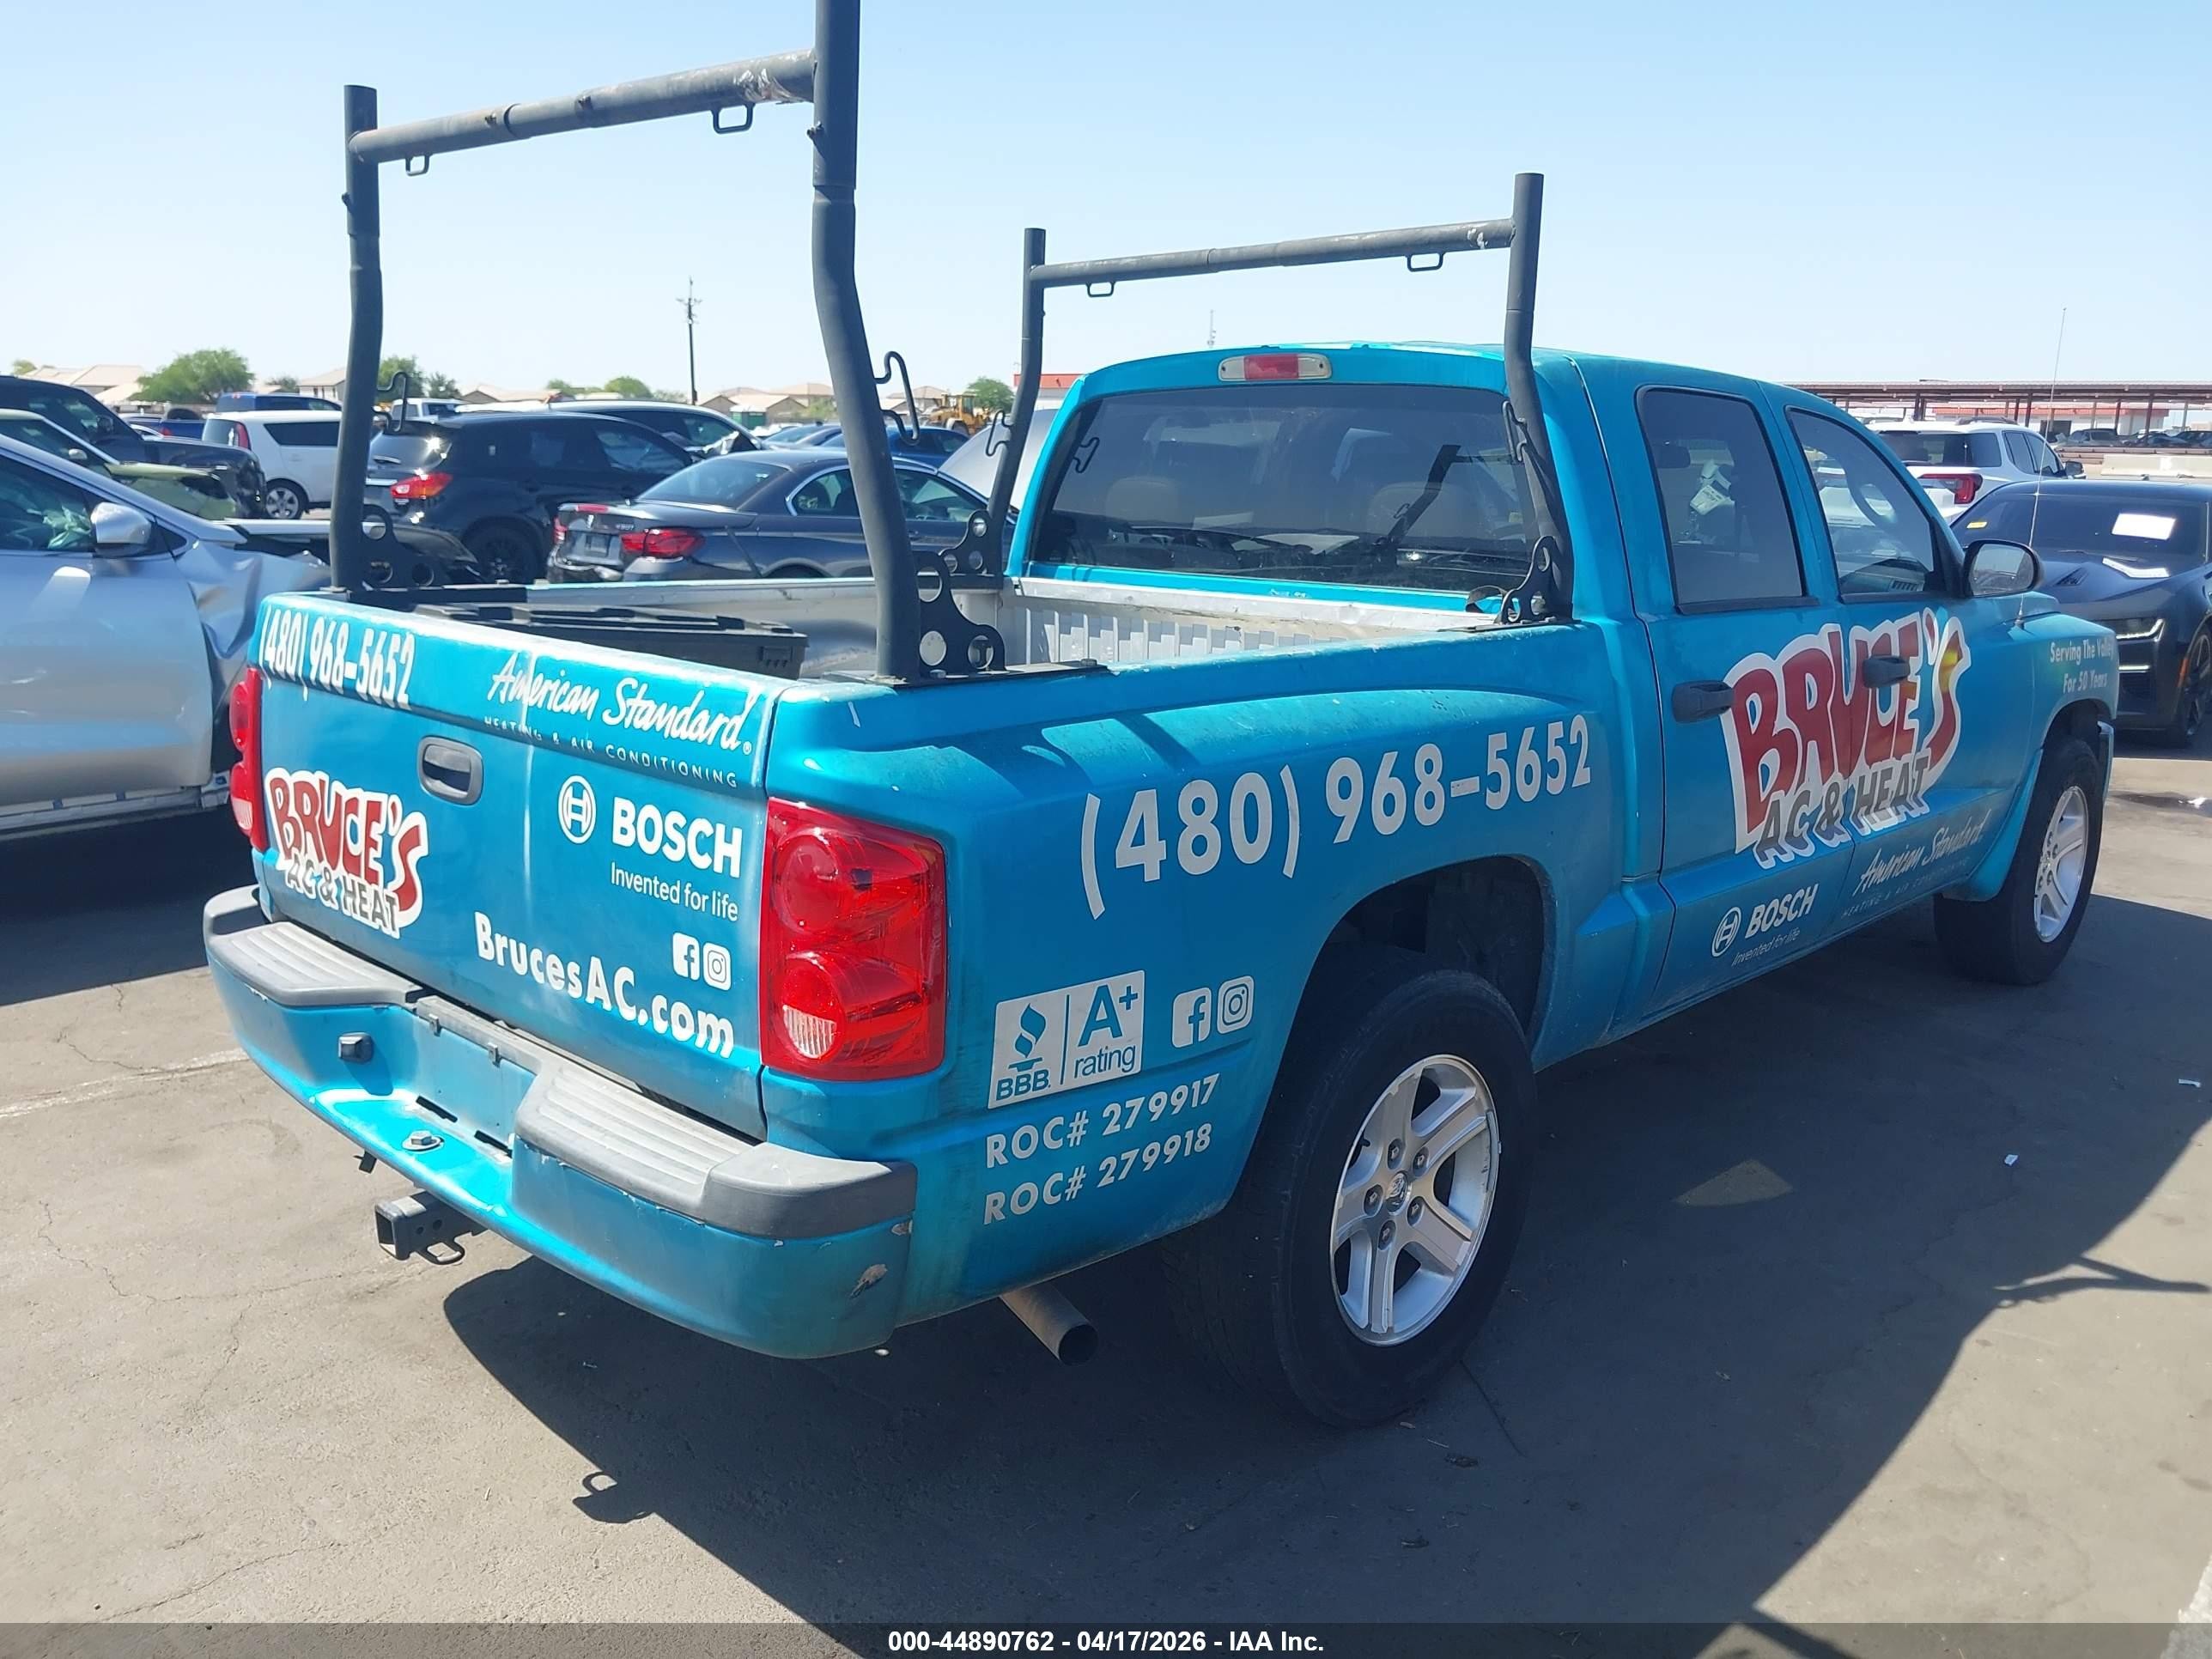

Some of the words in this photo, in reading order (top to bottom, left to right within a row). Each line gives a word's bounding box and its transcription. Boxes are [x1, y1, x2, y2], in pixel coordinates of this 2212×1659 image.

[259, 605, 309, 701] (480)
[310, 617, 415, 711] 968-5652
[487, 650, 599, 721] American
[2050, 641, 2081, 665] Serving
[2082, 639, 2095, 659] The
[2063, 672, 2076, 694] For
[2077, 670, 2088, 691] 50
[2089, 670, 2108, 689] Years
[571, 738, 594, 754] AIR
[605, 744, 738, 788] CONDITIONING
[1728, 610, 1967, 840] BRUCE'S
[267, 774, 424, 915] BRUCE'S
[612, 795, 743, 879] BOSCH
[1080, 765, 1301, 921] (480)
[1325, 714, 1591, 844] 968-5652
[1754, 788, 1812, 862] AC
[1814, 781, 1845, 841] &
[1850, 754, 1930, 830] HEAT
[286, 852, 317, 895] AC
[319, 865, 337, 907] &
[342, 875, 398, 933] HEAT
[611, 861, 681, 904] Invented
[684, 883, 709, 912] for
[711, 891, 738, 922] life
[1851, 847, 1925, 896] American
[1745, 883, 1819, 939] BOSCH
[475, 911, 734, 1059] BrucesAC.com
[1731, 937, 1775, 968] Invented
[1078, 984, 1139, 1047] A+
[1074, 1044, 1137, 1079] rating
[987, 1109, 1089, 1169] ROC#
[1102, 1073, 1220, 1136] 279917
[984, 1165, 1086, 1224] ROC#
[1097, 1122, 1212, 1188] 279918
